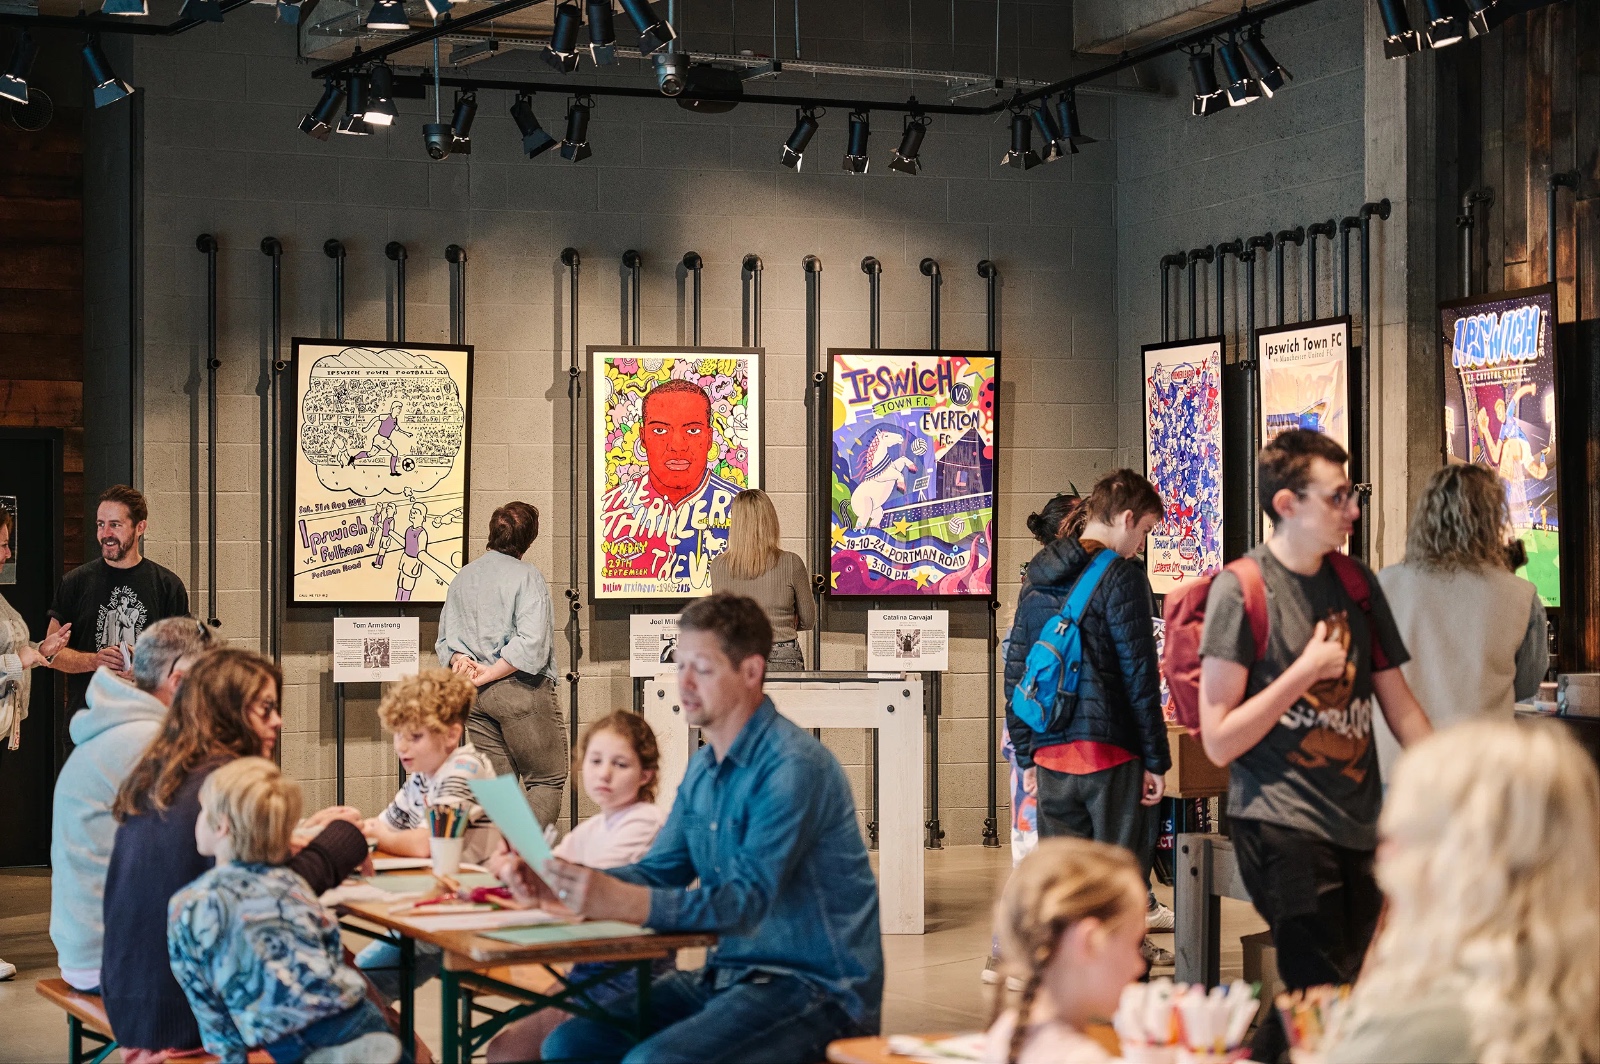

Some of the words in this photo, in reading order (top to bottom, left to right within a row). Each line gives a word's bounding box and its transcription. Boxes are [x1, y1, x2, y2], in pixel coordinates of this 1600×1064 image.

[1265, 337, 1300, 360] Ipswich
[1303, 336, 1328, 352] Town
[1331, 331, 1342, 348] FC
[1452, 305, 1541, 368] IPSWICH
[1279, 353, 1307, 363] Manchester
[1307, 350, 1325, 360] United
[1326, 348, 1334, 358] FC
[841, 360, 953, 405] IPSWICH
[1476, 371, 1502, 381] CRYSTAL
[1503, 367, 1527, 379] PALACE
[880, 397, 912, 414] TOWN
[915, 396, 931, 408] F.C.
[923, 409, 980, 431] EVERTON
[601, 475, 651, 512] THE
[298, 516, 368, 556] Ipswich
[320, 543, 365, 562] Fulham
[601, 540, 648, 556] SUNDAY
[846, 538, 885, 553] 19-10-24
[888, 547, 938, 563] PORTMAN
[938, 554, 966, 568] ROAD
[311, 565, 342, 580] Portman
[342, 560, 362, 573] Road
[601, 565, 648, 578] SEPTEMBER
[608, 557, 633, 569] 29TH
[651, 548, 688, 585] THE
[872, 558, 892, 576] 3:00
[367, 622, 401, 630] Armstrong
[908, 614, 933, 622] Carvajal
